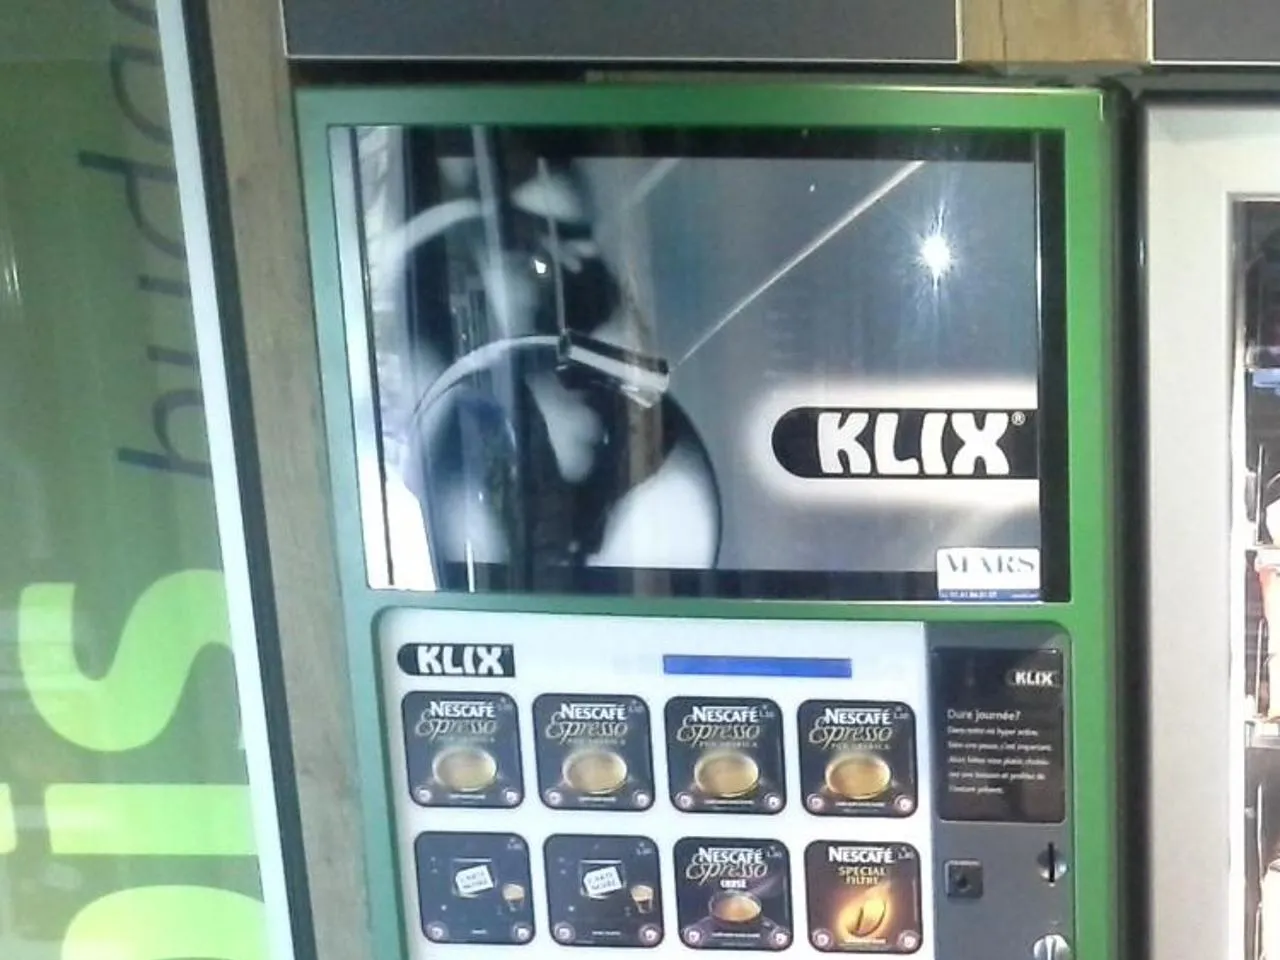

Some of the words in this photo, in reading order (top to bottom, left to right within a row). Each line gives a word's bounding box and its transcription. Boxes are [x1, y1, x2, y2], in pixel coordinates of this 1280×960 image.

[947, 554, 1035, 573] MARS
[417, 646, 504, 675] KLIX
[1015, 671, 1054, 686] KLIX
[561, 703, 628, 720] NESCAFÉ
[693, 706, 760, 723] NESCAFÉ
[825, 708, 892, 725] NESCAFÉ
[699, 848, 763, 864] NESCAFÉ
[828, 847, 895, 864] NESCAFÉ
